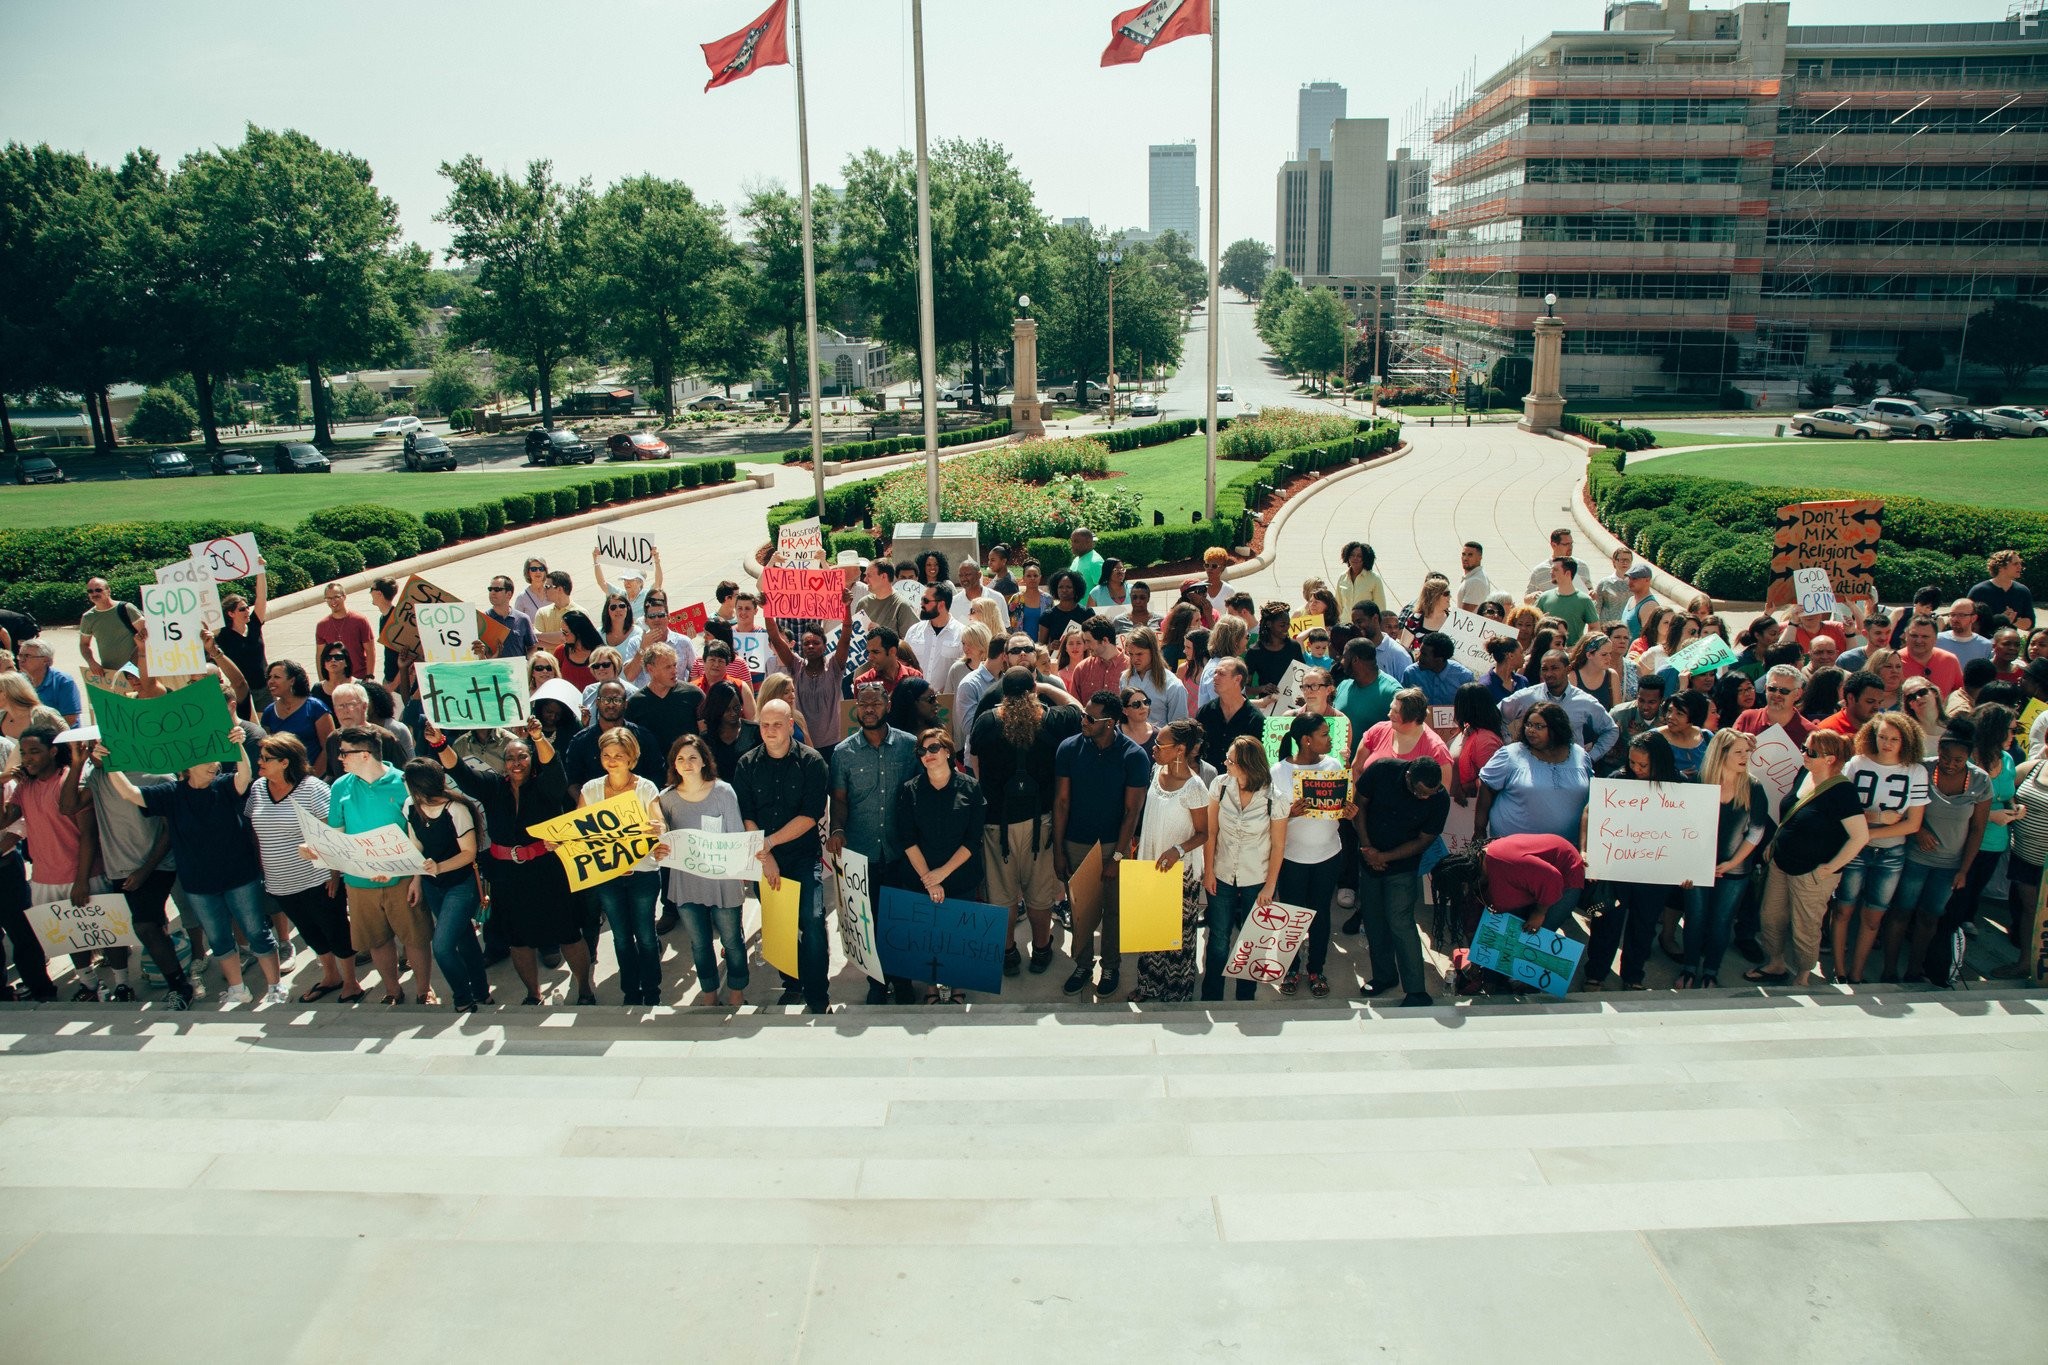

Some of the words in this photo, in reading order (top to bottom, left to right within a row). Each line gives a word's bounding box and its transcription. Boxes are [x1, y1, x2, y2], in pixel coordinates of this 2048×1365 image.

[1802, 508, 1850, 526] Don't
[781, 533, 823, 549] PRAYER
[795, 551, 815, 560] NOT
[1798, 542, 1858, 562] Religion
[765, 568, 798, 592] WE
[1798, 570, 1824, 583] GOD
[145, 587, 197, 616] GOD
[418, 605, 465, 629] GOD
[1452, 611, 1474, 633] We
[422, 673, 524, 723] truth
[136, 703, 205, 739] GOD
[131, 741, 174, 770] NOT
[1604, 787, 1649, 811] Keep
[689, 847, 727, 862] WITH
[1601, 842, 1669, 865] Yourself
[684, 857, 727, 875] GOD
[49, 904, 106, 921] Praise
[887, 894, 949, 928] LET
[957, 911, 996, 937] MY
[76, 921, 99, 932] the
[68, 929, 118, 950] LORD
